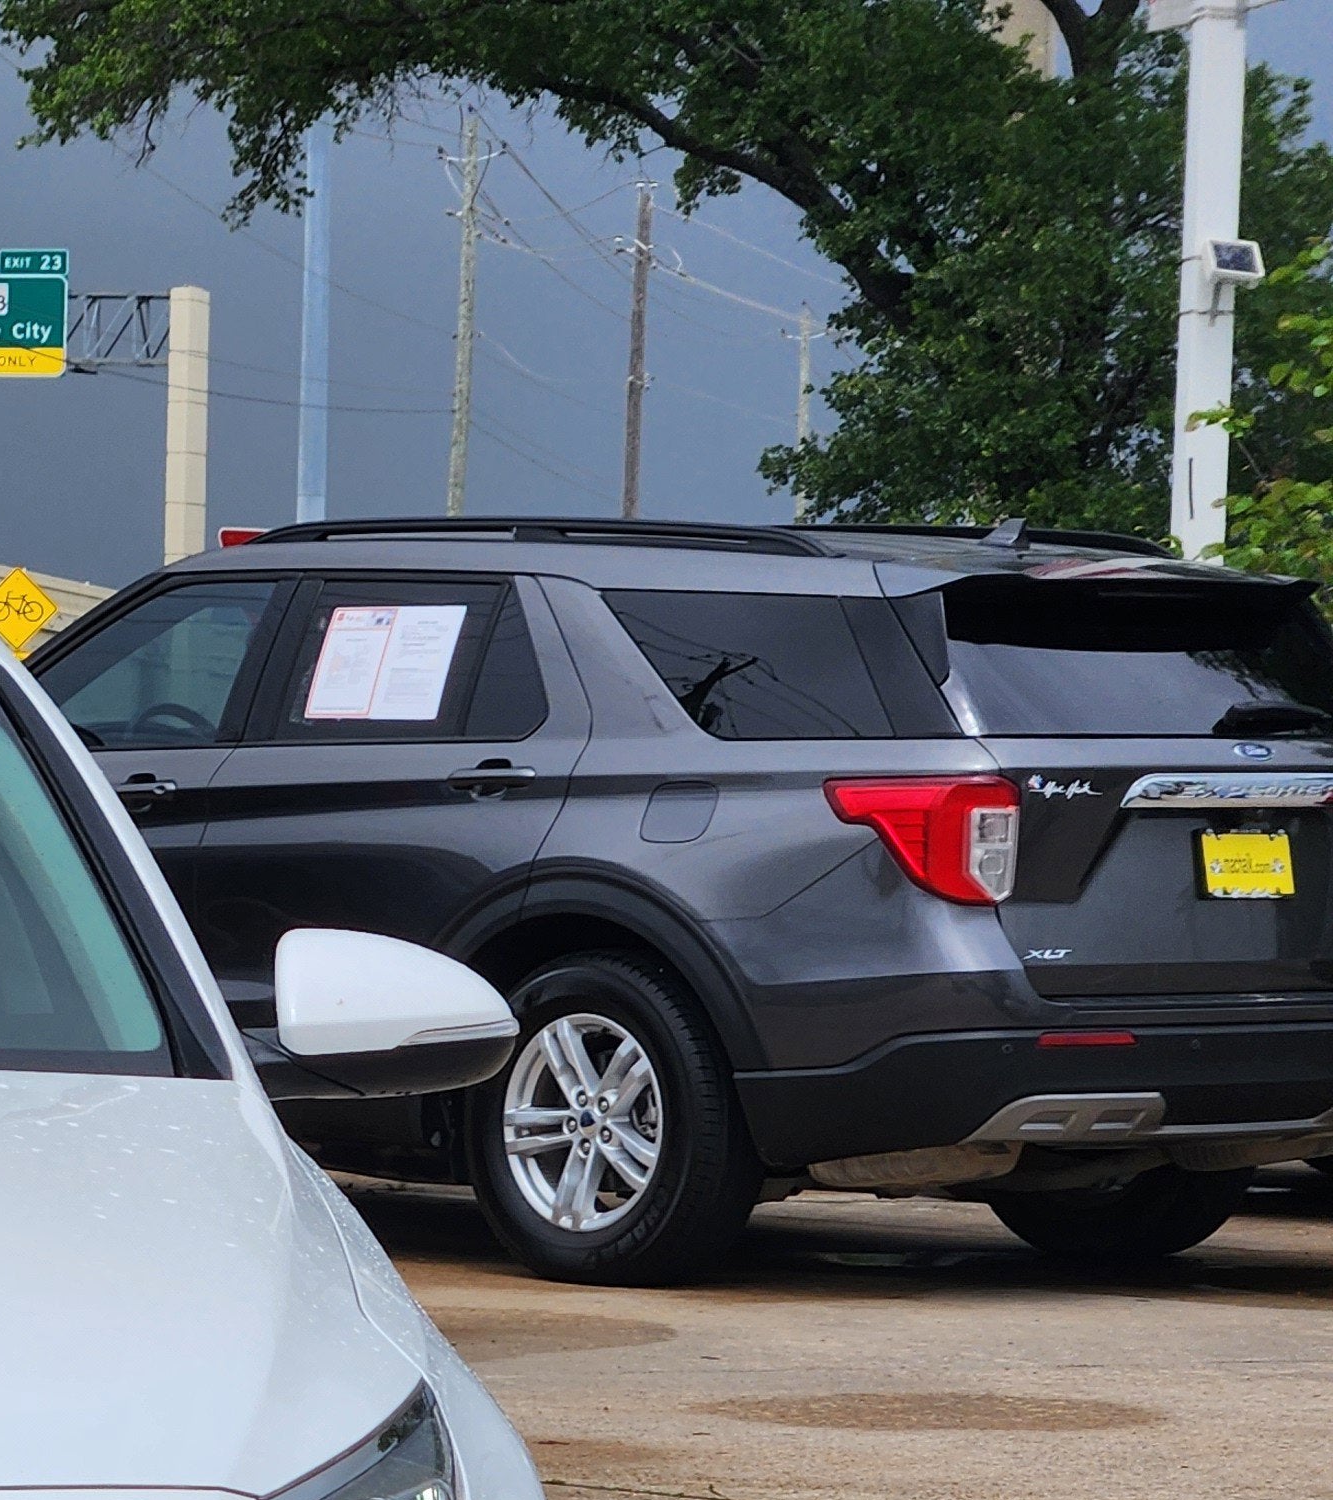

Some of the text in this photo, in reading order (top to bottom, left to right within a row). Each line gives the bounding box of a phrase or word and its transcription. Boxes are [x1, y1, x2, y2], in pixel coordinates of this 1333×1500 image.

[4, 255, 62, 271] EXIT 23
[12, 320, 52, 344] City
[1023, 948, 1073, 960] XLT
